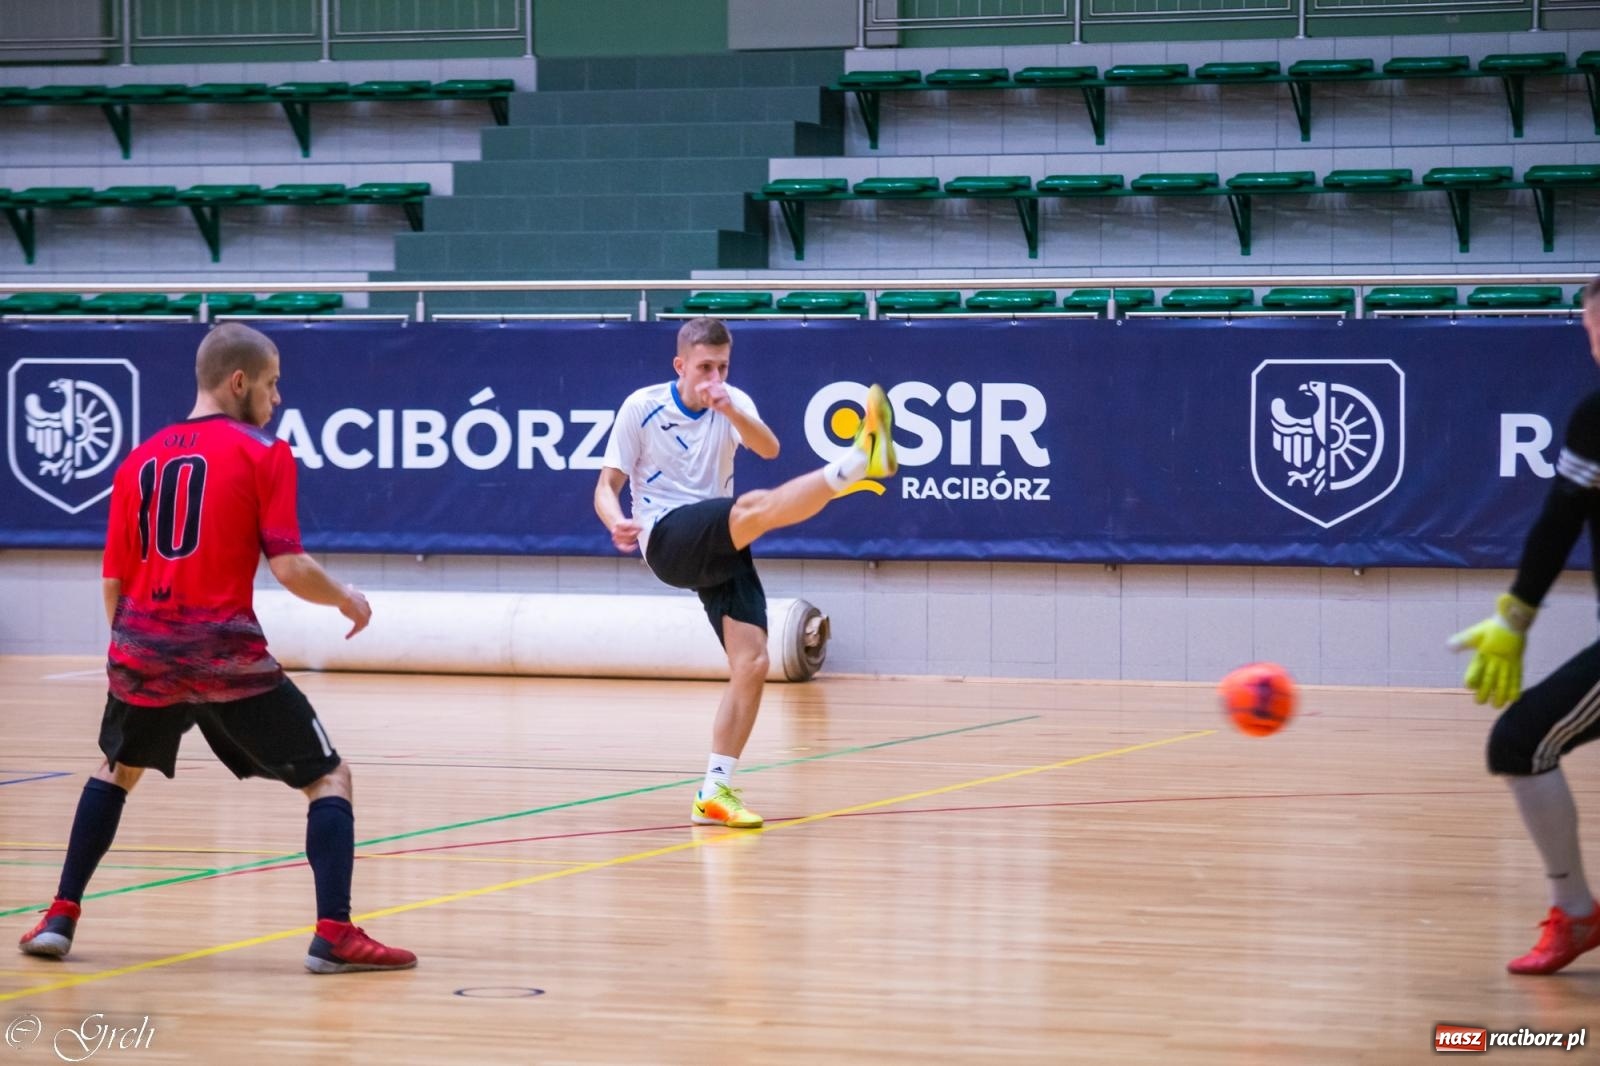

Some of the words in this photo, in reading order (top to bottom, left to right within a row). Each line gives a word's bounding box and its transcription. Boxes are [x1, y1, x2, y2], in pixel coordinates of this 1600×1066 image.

[803, 380, 1051, 468] OSiR
[138, 453, 208, 562] 10
[901, 469, 1051, 501] RACIBÓRZ
